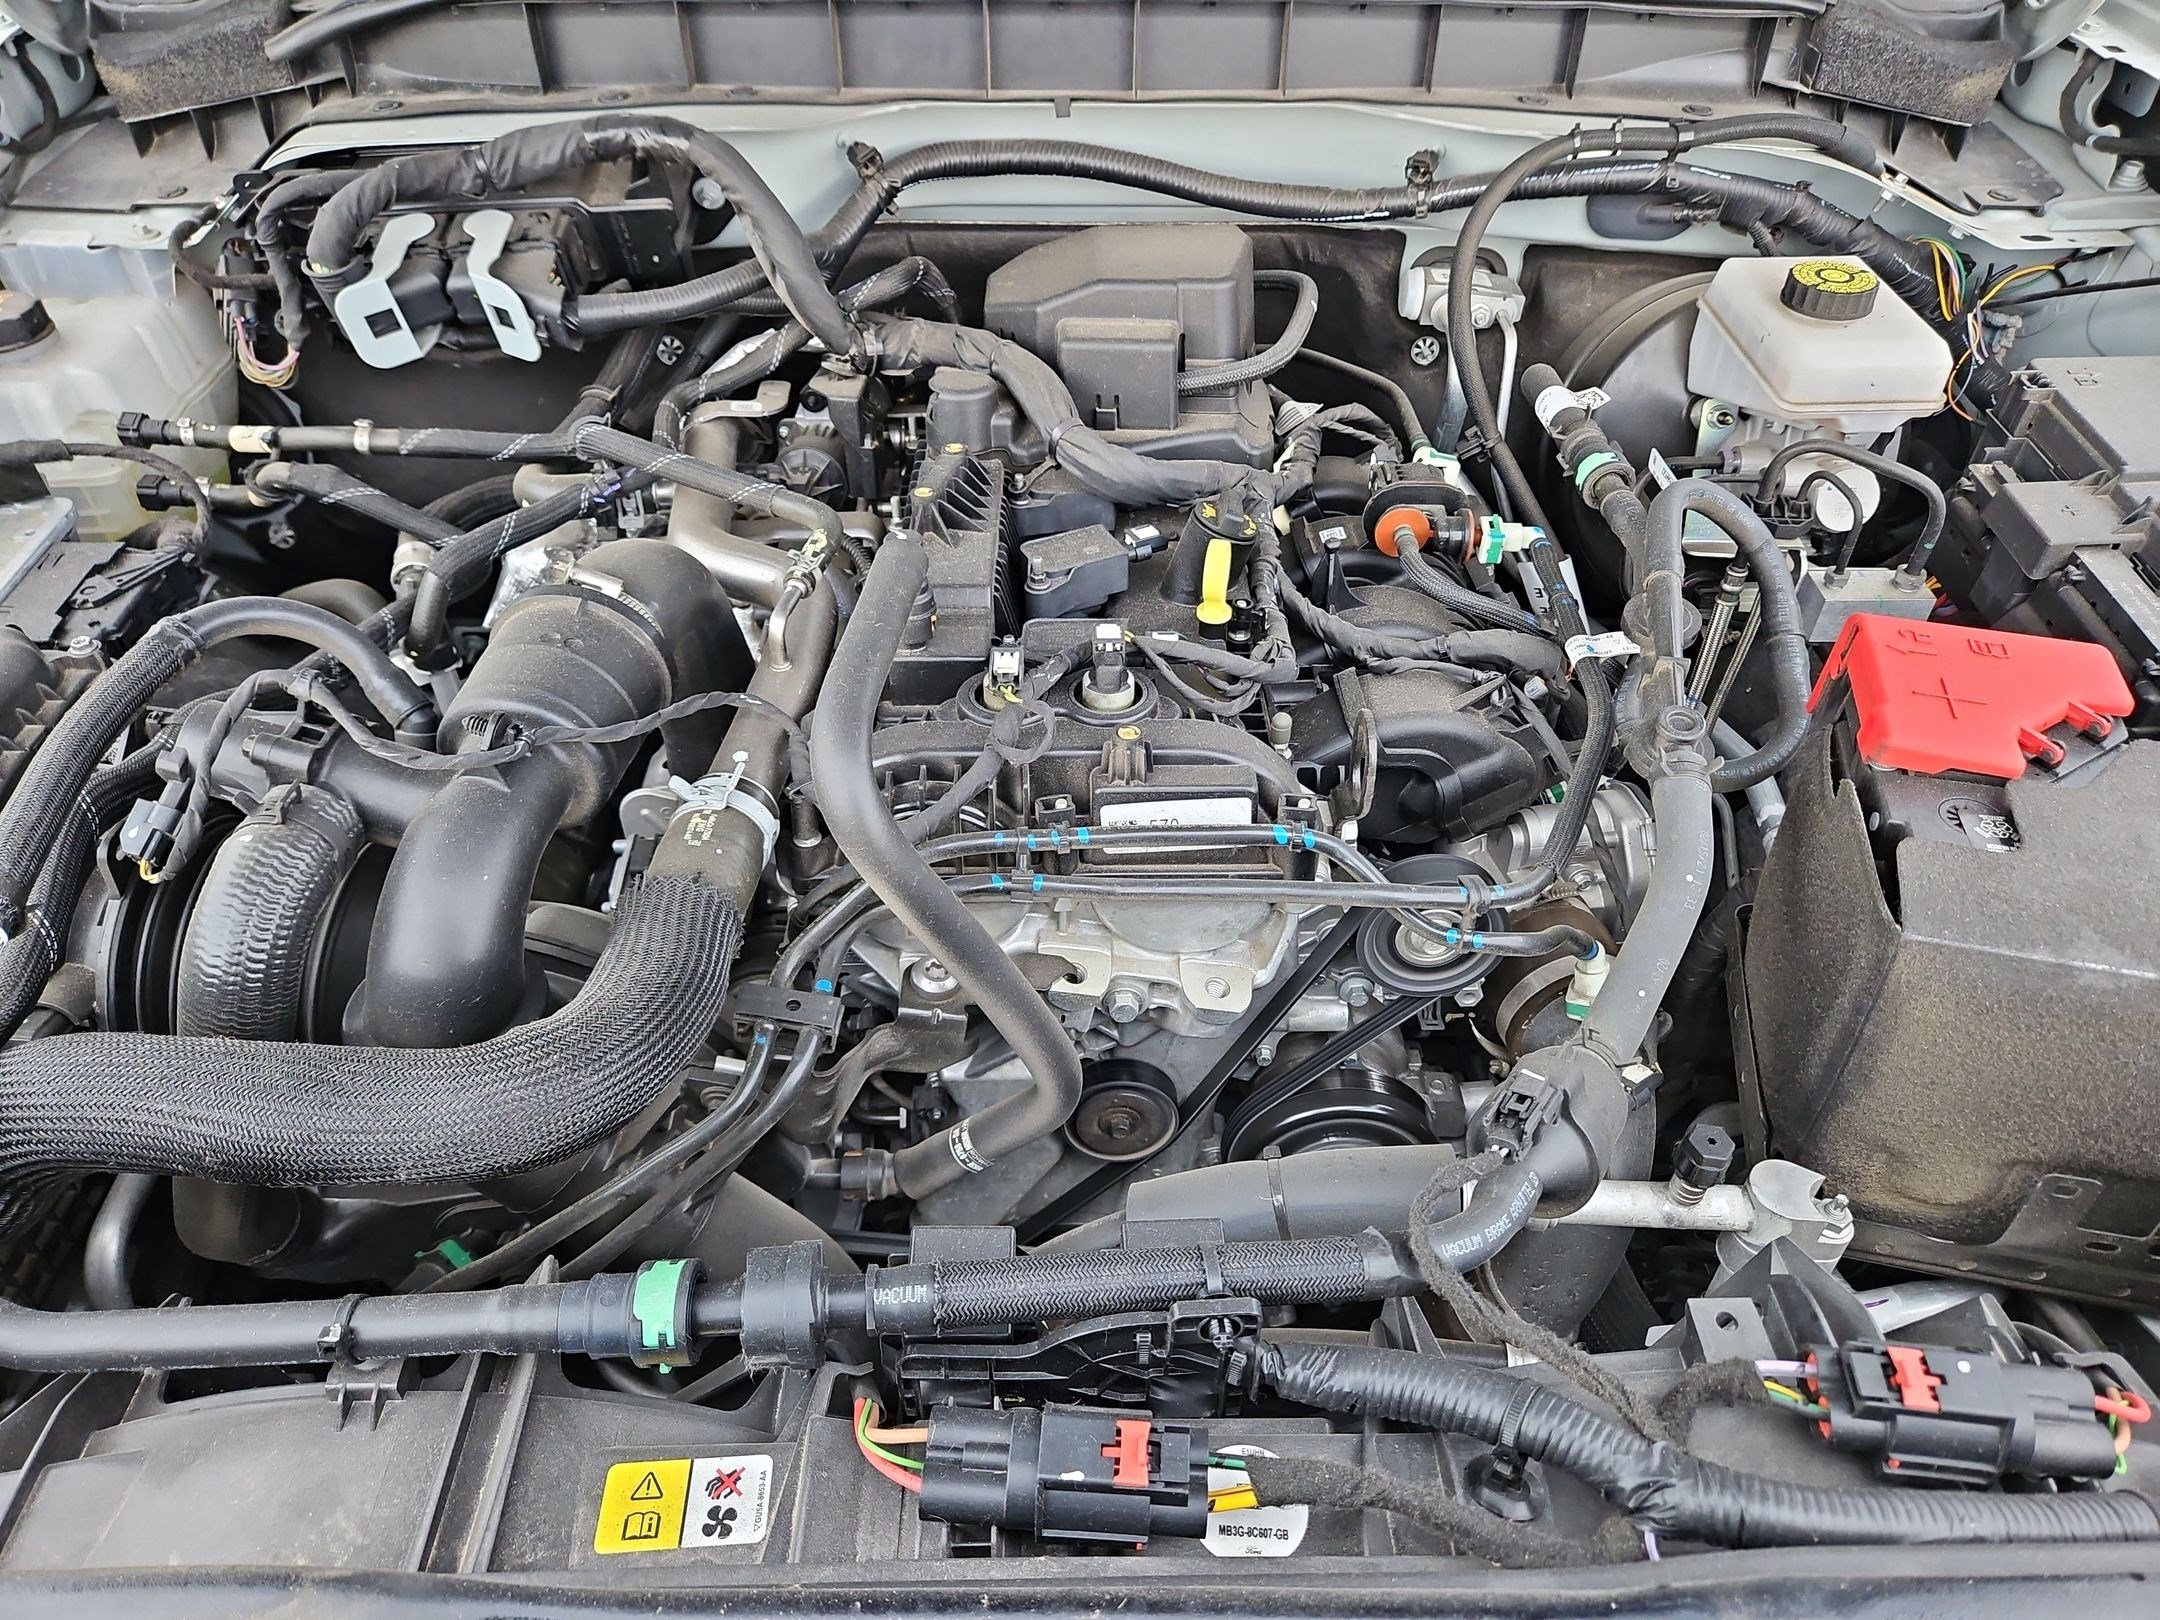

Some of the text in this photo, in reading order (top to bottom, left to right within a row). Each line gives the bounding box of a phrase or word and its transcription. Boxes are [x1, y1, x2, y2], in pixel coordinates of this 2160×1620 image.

[1441, 1233, 1484, 1258] VACUUM
[1484, 1213, 1512, 1242] BRAKE
[873, 1284, 928, 1305] VACUUM
[1218, 1524, 1289, 1540] MB3G-8C607-GB
